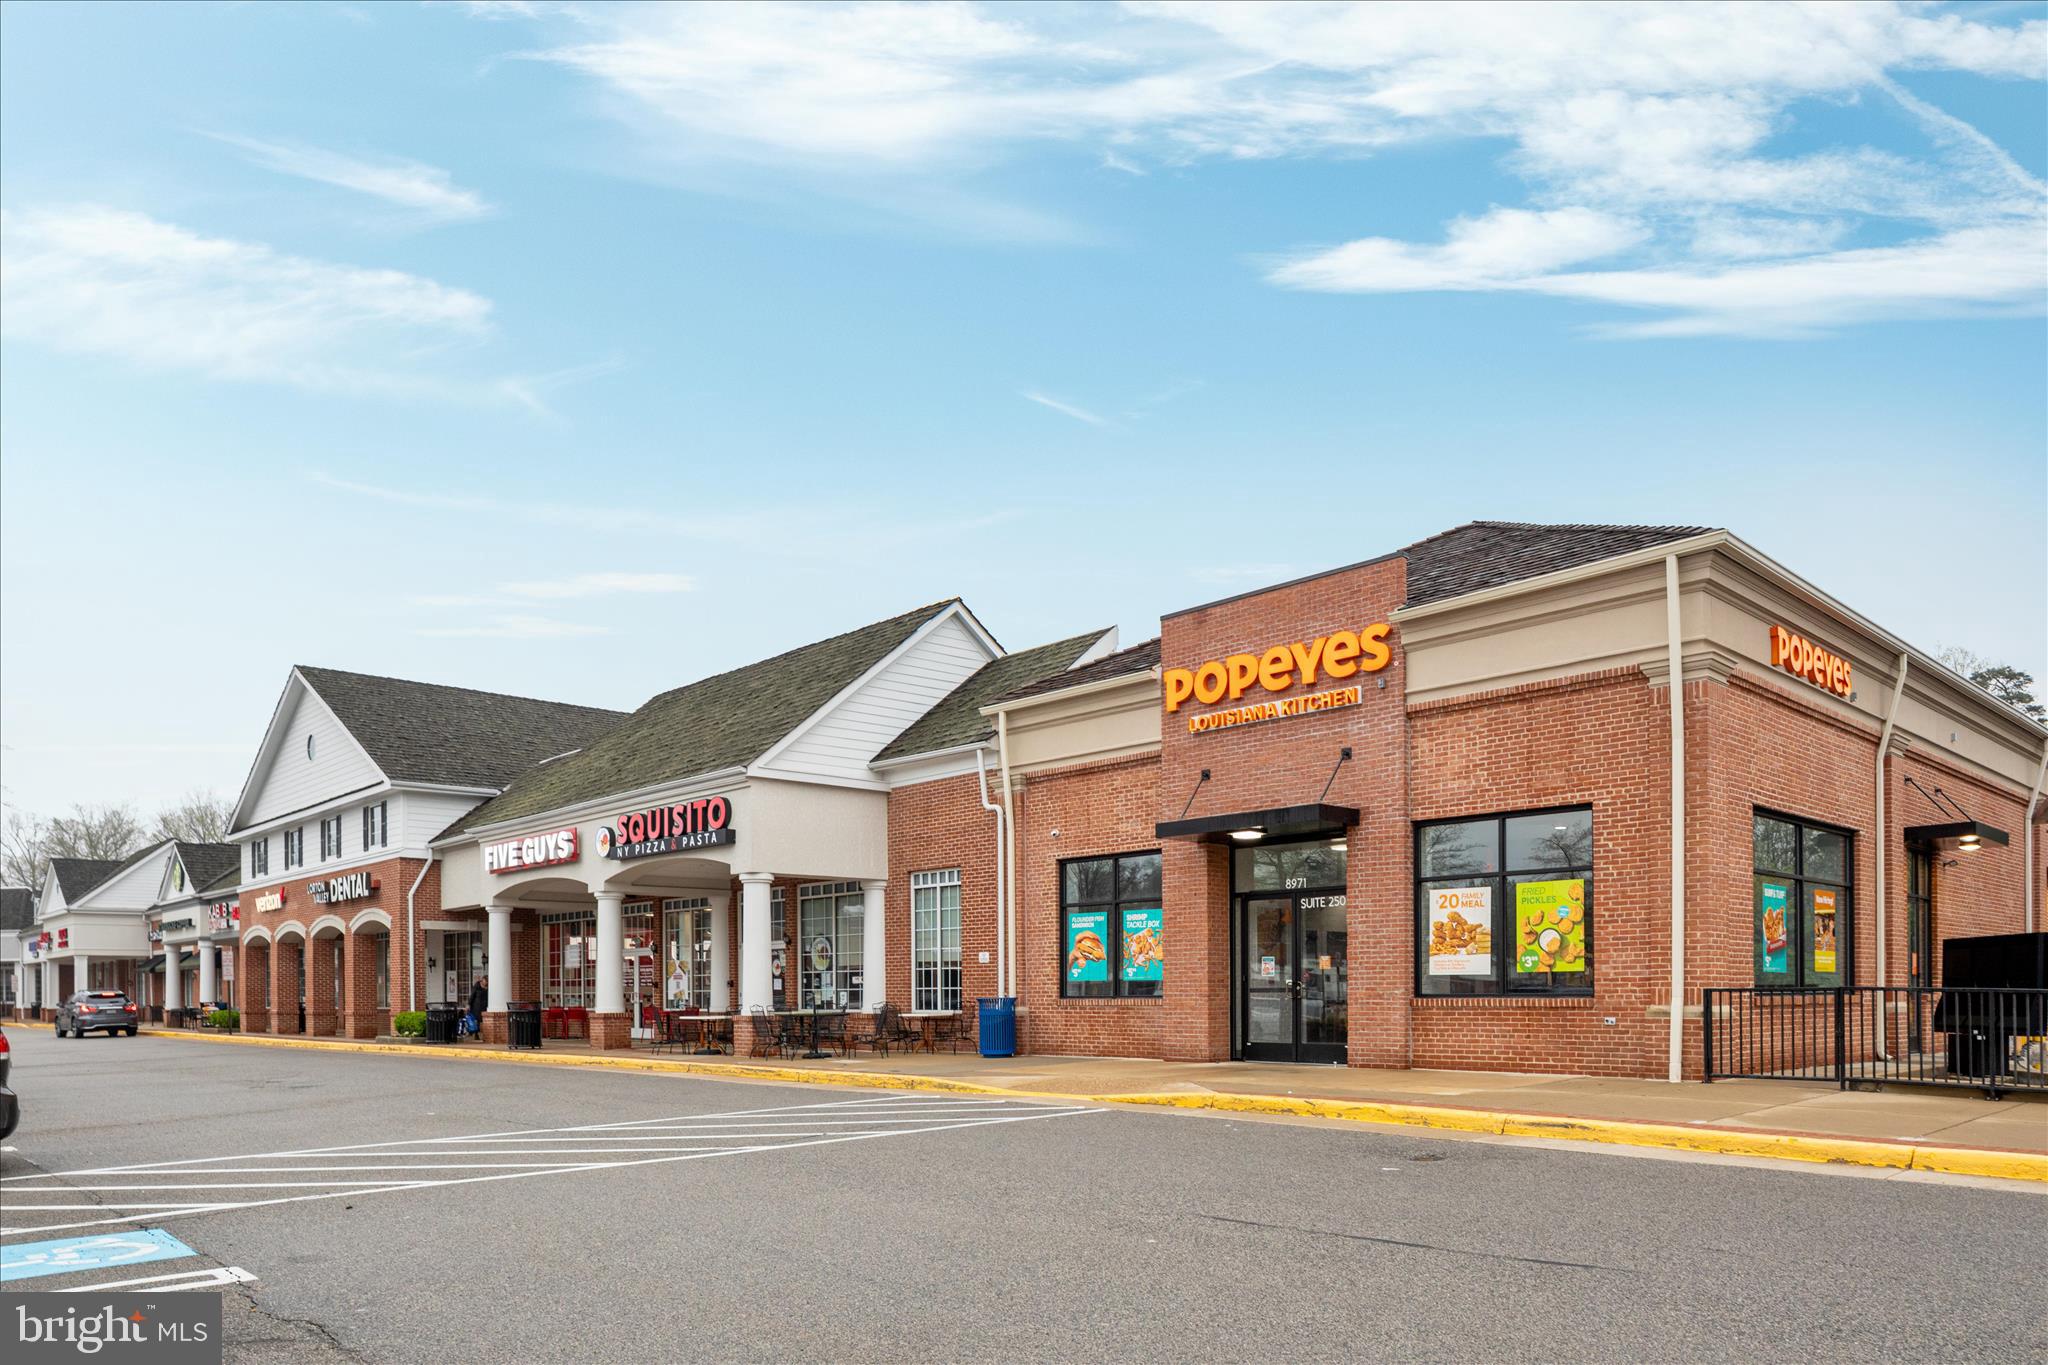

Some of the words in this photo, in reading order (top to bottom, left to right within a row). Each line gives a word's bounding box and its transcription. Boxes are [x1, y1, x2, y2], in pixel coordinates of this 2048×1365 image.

[1189, 703, 1277, 732] LOUISIANA
[1281, 687, 1359, 716] KITCHEN
[617, 796, 728, 845] SQUISITO
[485, 841, 518, 871] FIVE
[522, 831, 574, 866] GUYS
[617, 846, 629, 858] NY
[635, 840, 665, 855] PIZZA
[671, 840, 678, 850] &
[682, 834, 718, 848] PASTA
[330, 872, 370, 903] DENTAL
[1285, 878, 1307, 889] 8971
[1461, 892, 1485, 901] FAMILY
[1521, 887, 1545, 896] FRIED
[1300, 897, 1326, 909] SUITE
[1328, 896, 1346, 907] 250
[1461, 900, 1485, 909] MEAL
[1521, 896, 1557, 905] PICKLES
[1126, 919, 1147, 929] TACKLE
[1147, 920, 1160, 928] BOX
